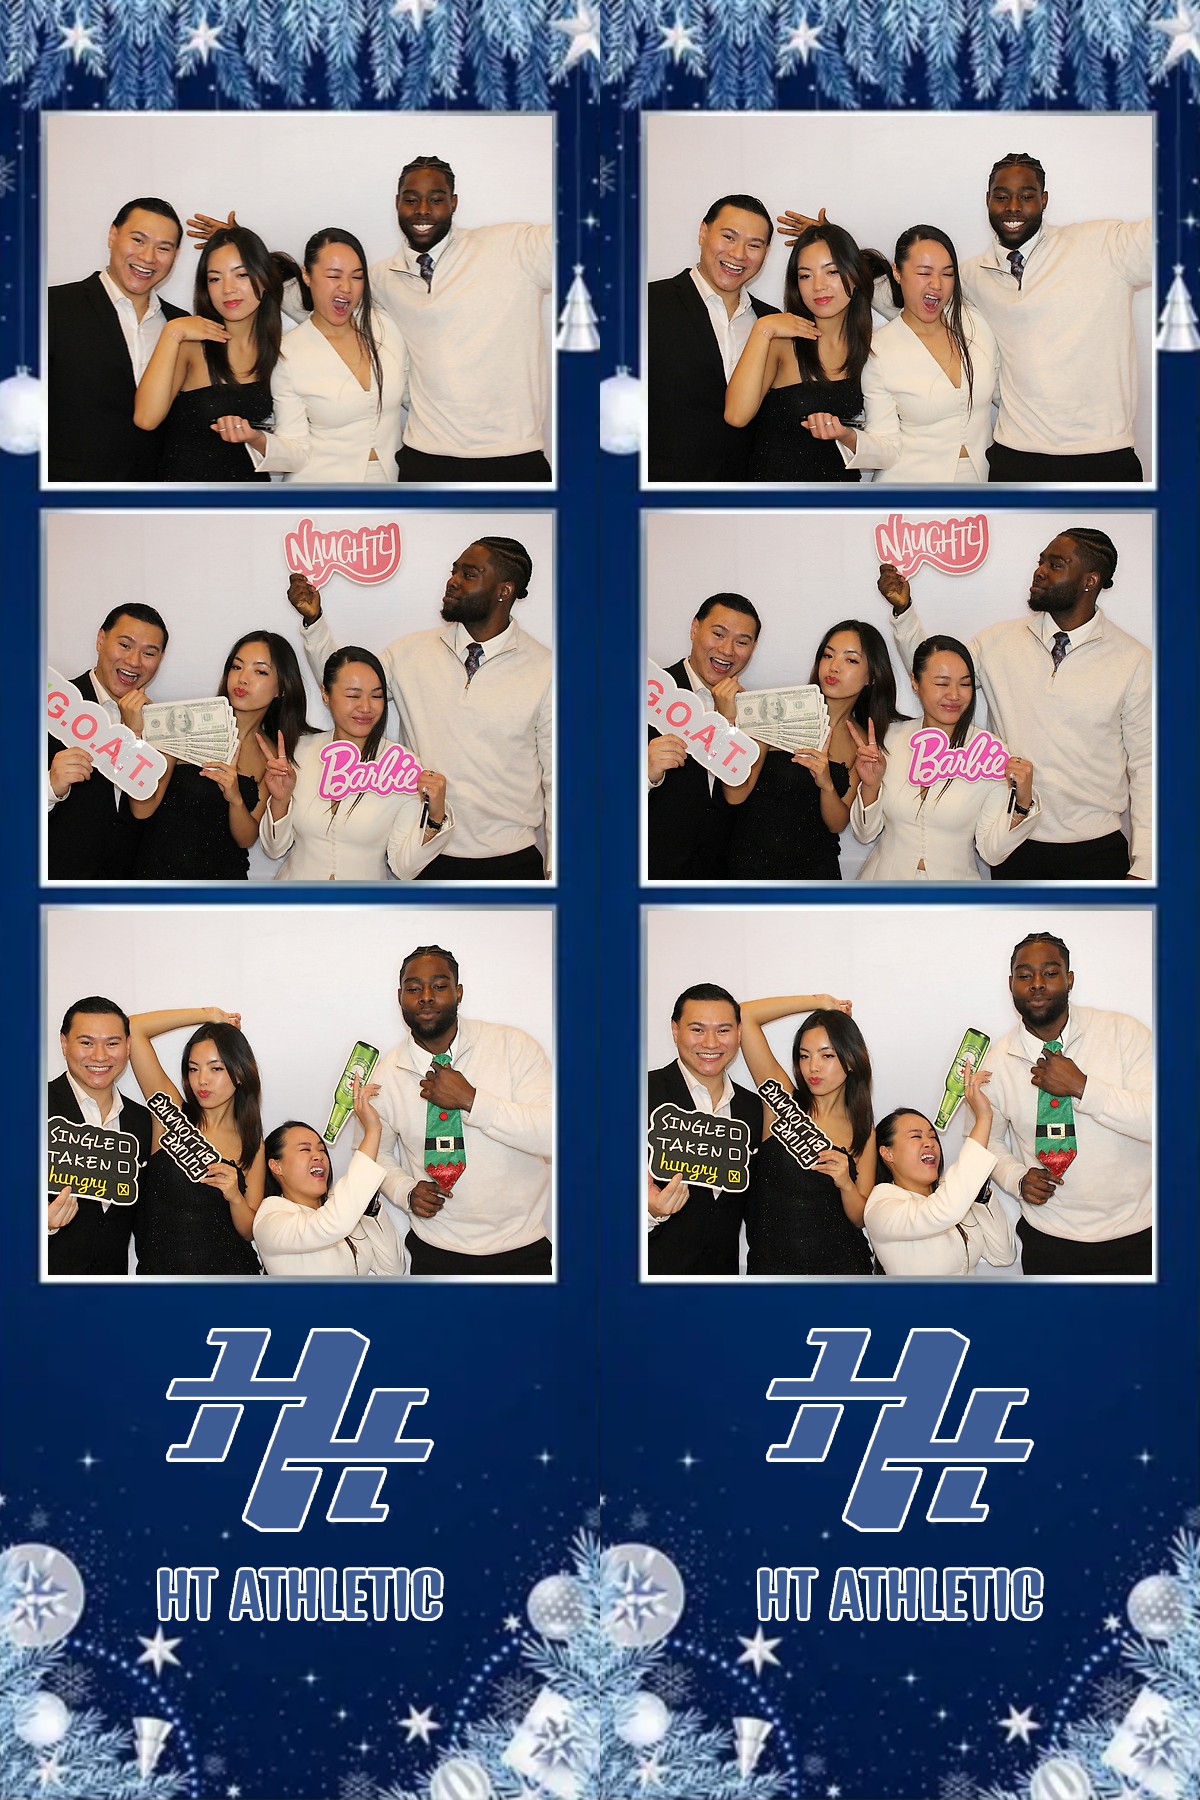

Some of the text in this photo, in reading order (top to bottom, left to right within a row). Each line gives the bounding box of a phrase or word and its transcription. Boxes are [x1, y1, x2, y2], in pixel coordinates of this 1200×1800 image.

[323, 745, 418, 798] Barbie
[913, 733, 1005, 783] Barbie
[150, 1095, 217, 1166] BILLIONAIRE
[661, 1113, 726, 1138] SINGLE
[761, 1082, 828, 1152] BILLIONAIRE
[51, 1126, 115, 1151] SINGLE
[163, 1132, 207, 1177] FUTURE
[656, 1137, 722, 1158] TAKEN
[774, 1119, 818, 1164] FUTURE
[48, 1151, 111, 1171] TAKEN
[660, 1152, 718, 1184] hungry
[49, 1165, 107, 1197] hungry
